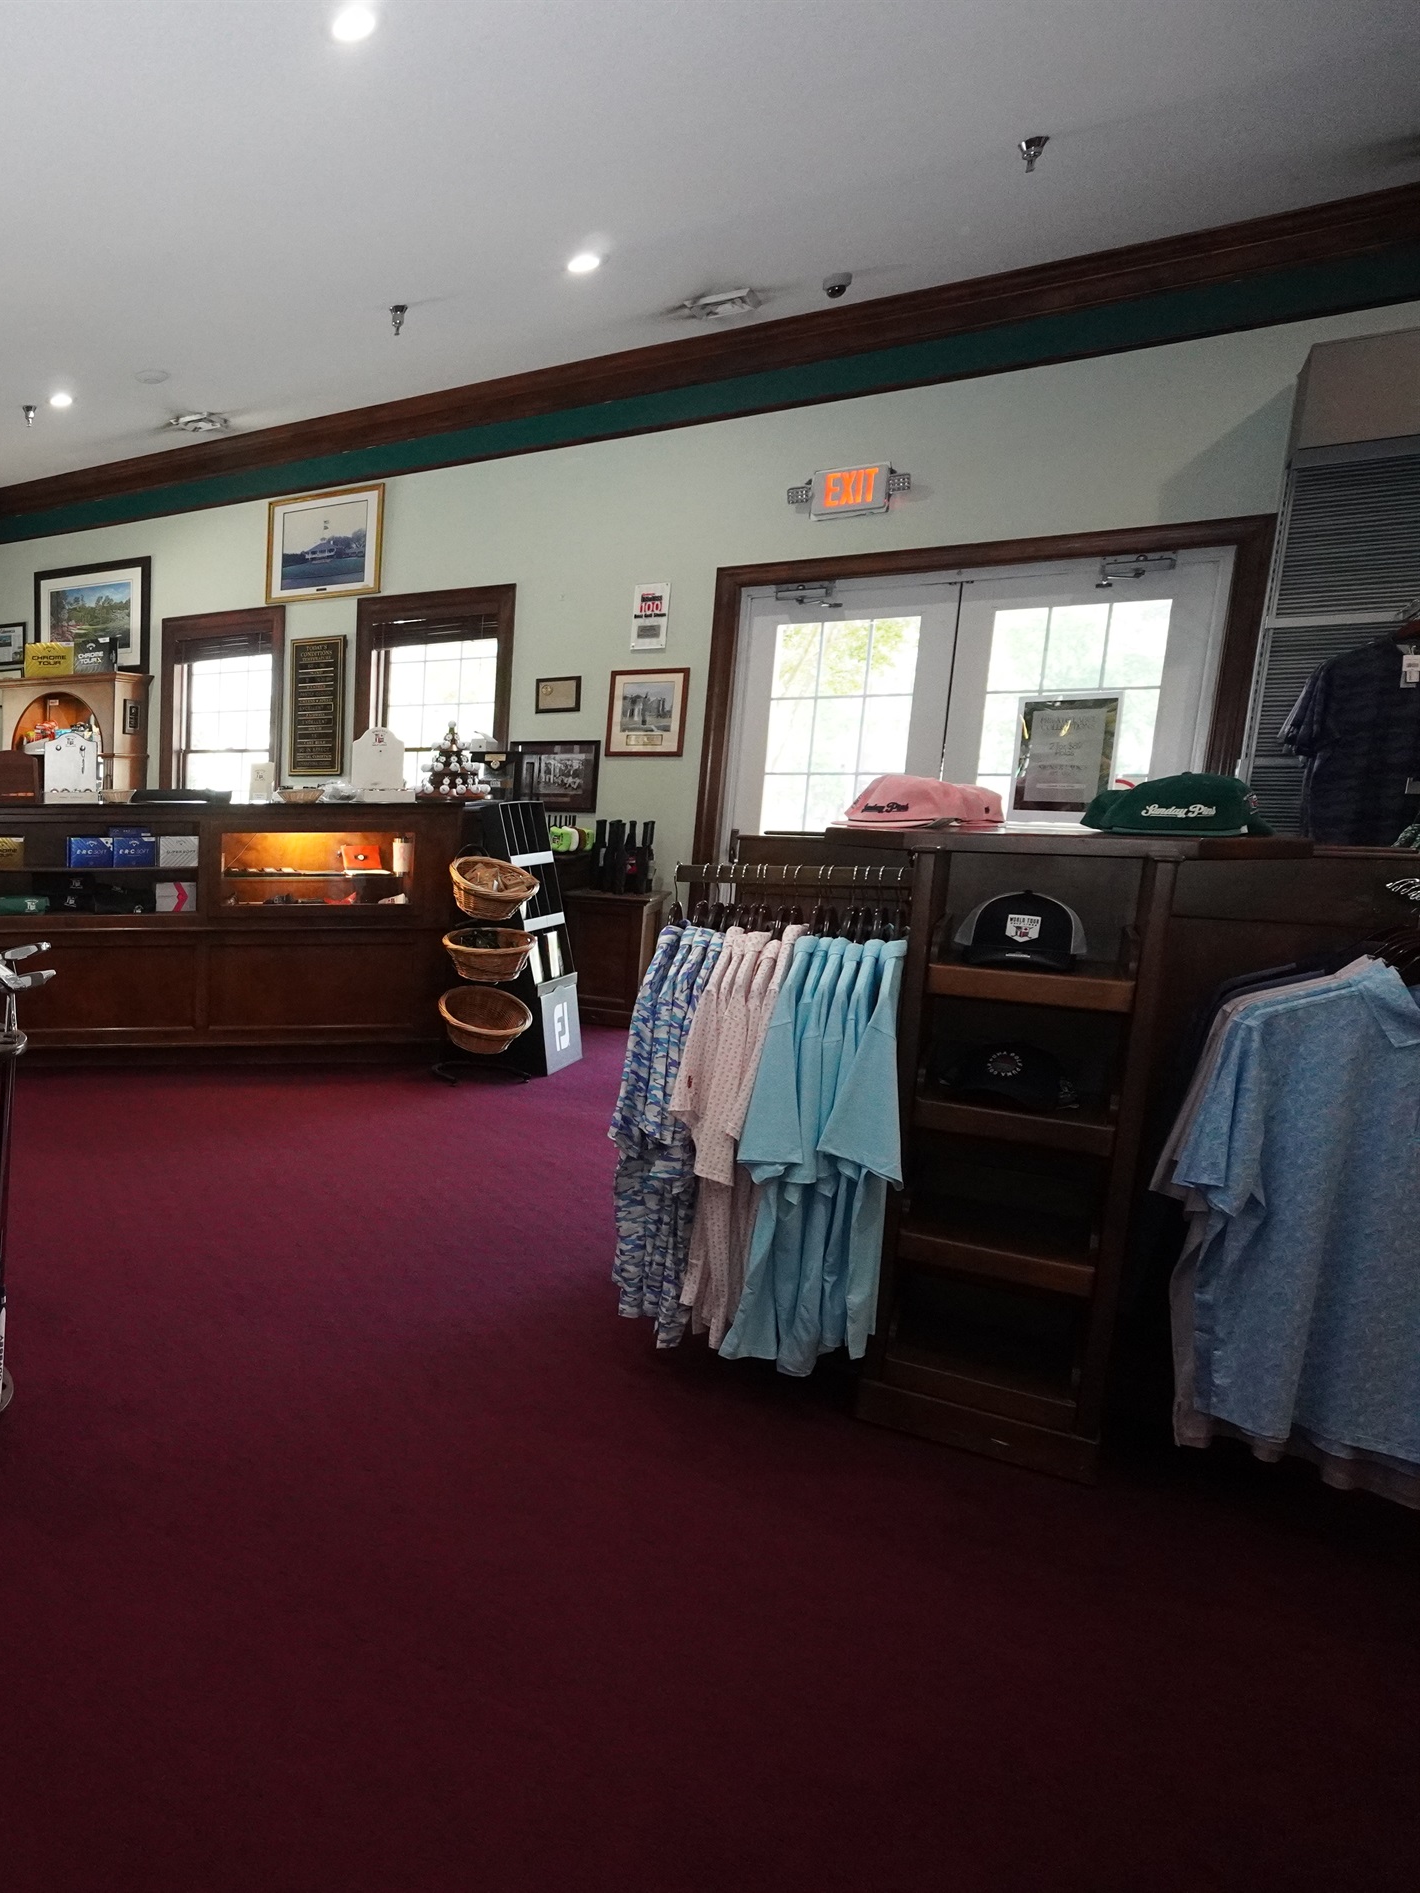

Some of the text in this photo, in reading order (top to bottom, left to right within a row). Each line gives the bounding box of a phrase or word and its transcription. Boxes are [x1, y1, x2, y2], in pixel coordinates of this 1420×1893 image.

[824, 467, 879, 507] EXIT
[640, 602, 661, 612] 100
[78, 651, 104, 659] CHROME
[1141, 804, 1216, 818] Sunday Pins
[554, 1001, 570, 1051] FJ
